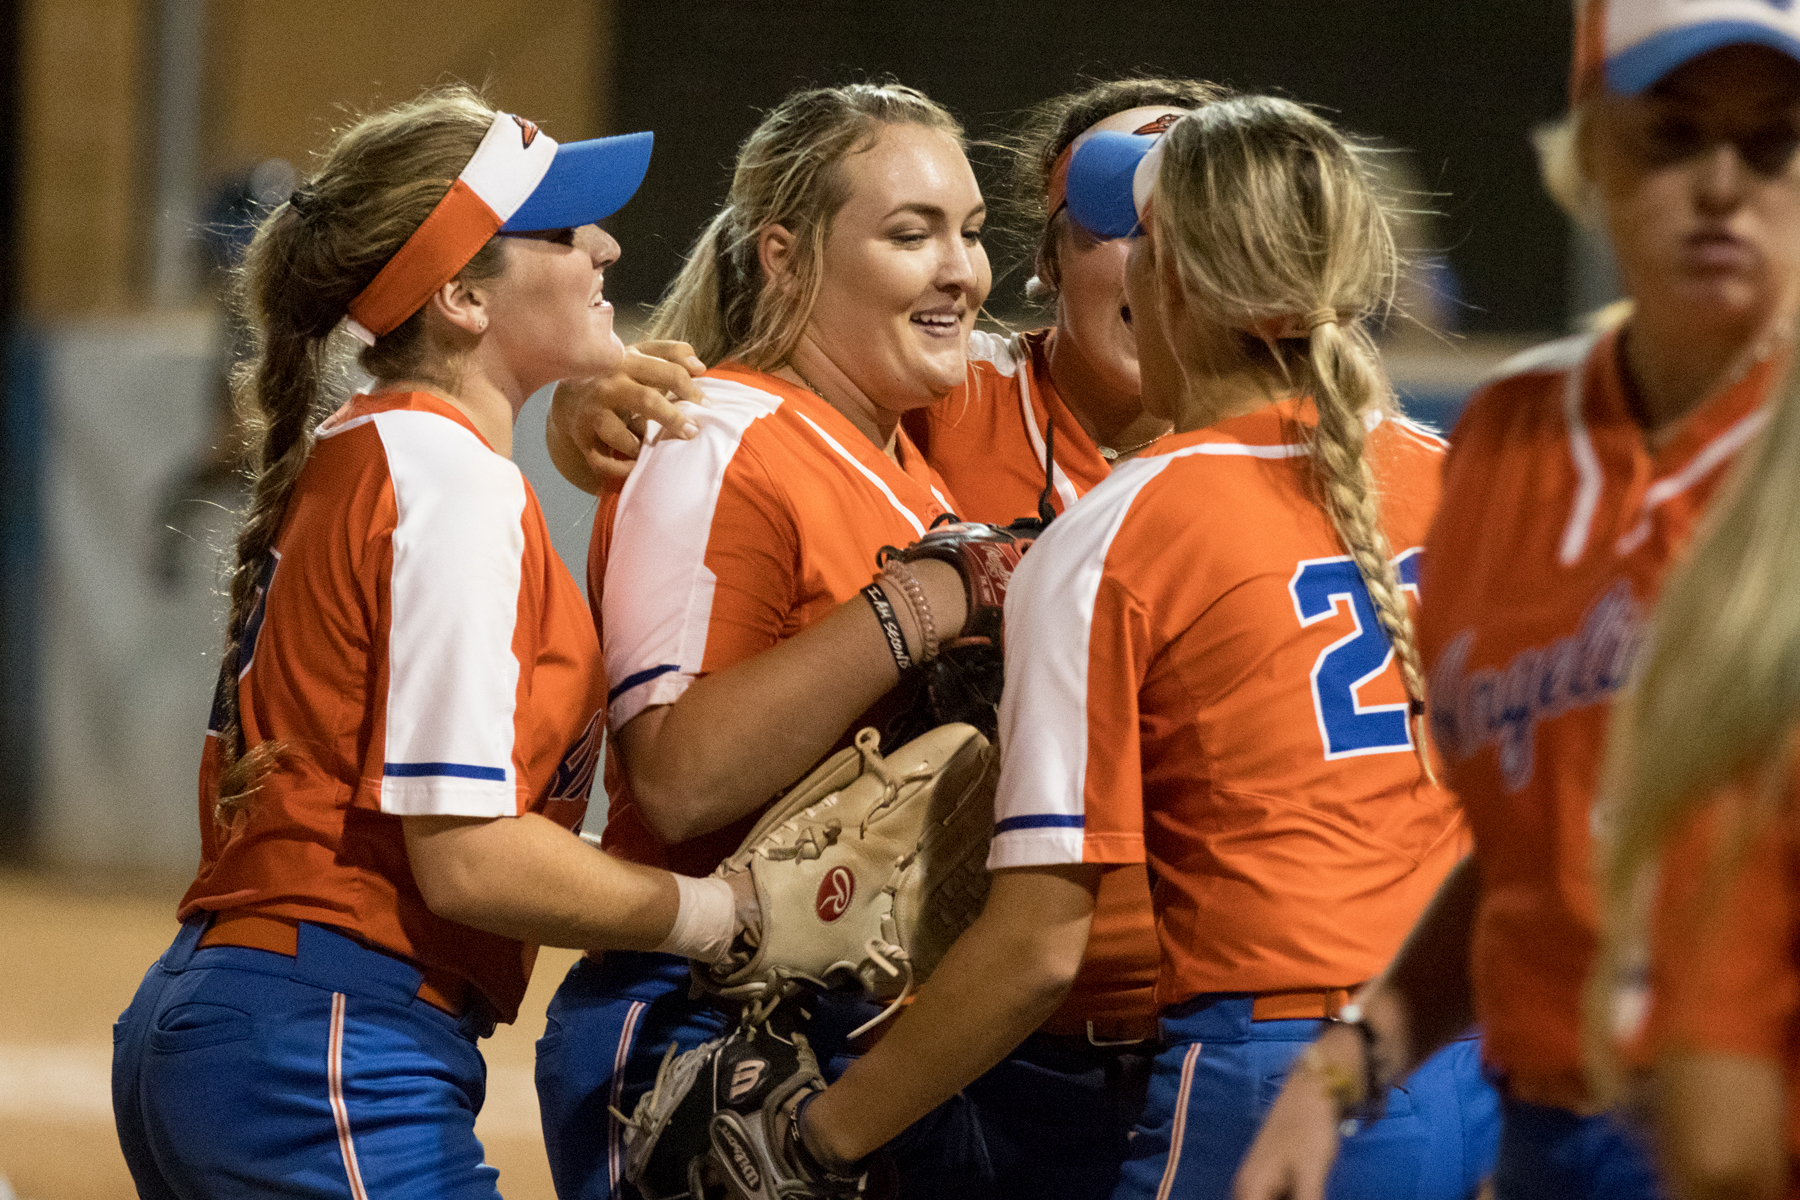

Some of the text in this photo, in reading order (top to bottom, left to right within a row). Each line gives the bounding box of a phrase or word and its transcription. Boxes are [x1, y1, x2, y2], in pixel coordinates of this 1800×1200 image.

[867, 586, 910, 669] I AM SECOND
